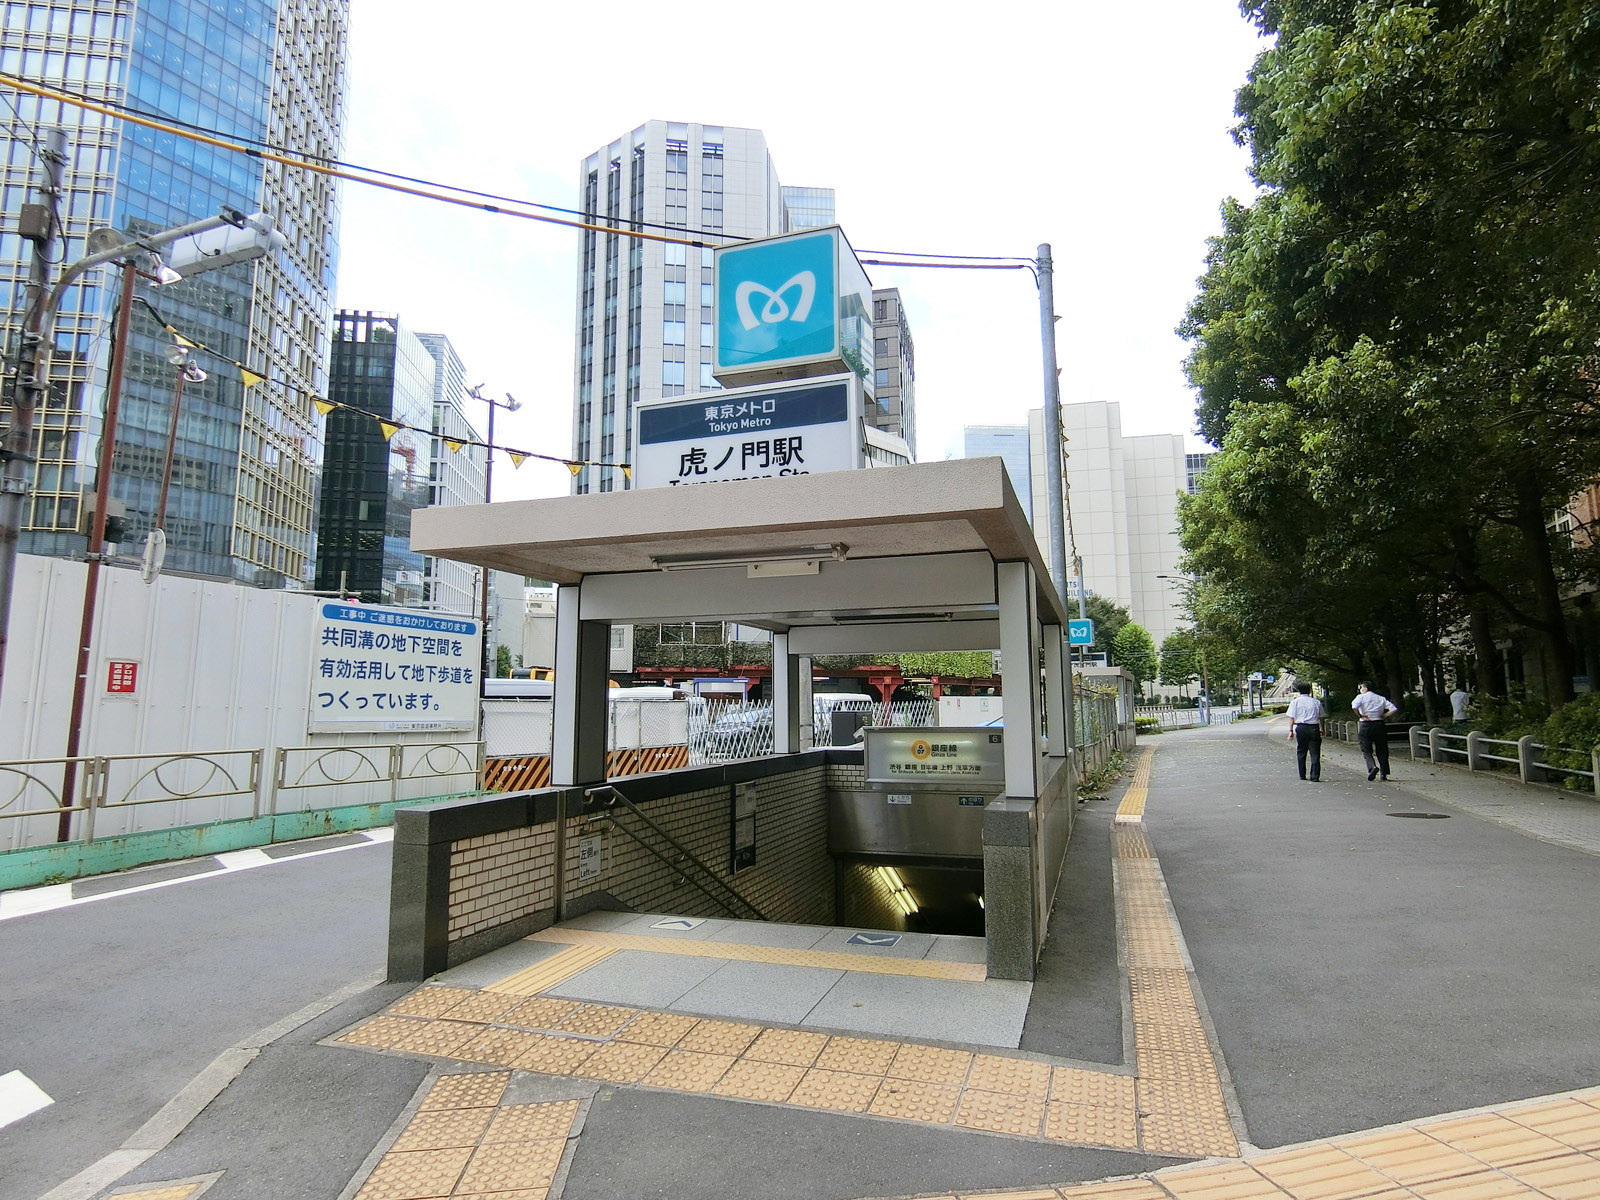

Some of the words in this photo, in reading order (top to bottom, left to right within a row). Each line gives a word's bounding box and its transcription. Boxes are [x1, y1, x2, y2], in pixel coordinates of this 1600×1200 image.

[704, 399, 775, 420] 東京メトロ
[709, 422, 738, 432] Tokyo
[741, 417, 771, 429] Metro
[679, 436, 804, 476] 虎ノ門駅
[340, 608, 366, 620] 工事中
[321, 626, 462, 657] 共同溝の地下空間を
[319, 657, 473, 684] 有効活用して地下歩道を
[318, 690, 440, 711] つくっています。
[931, 744, 957, 752] 銀座線
[992, 735, 998, 743] 6
